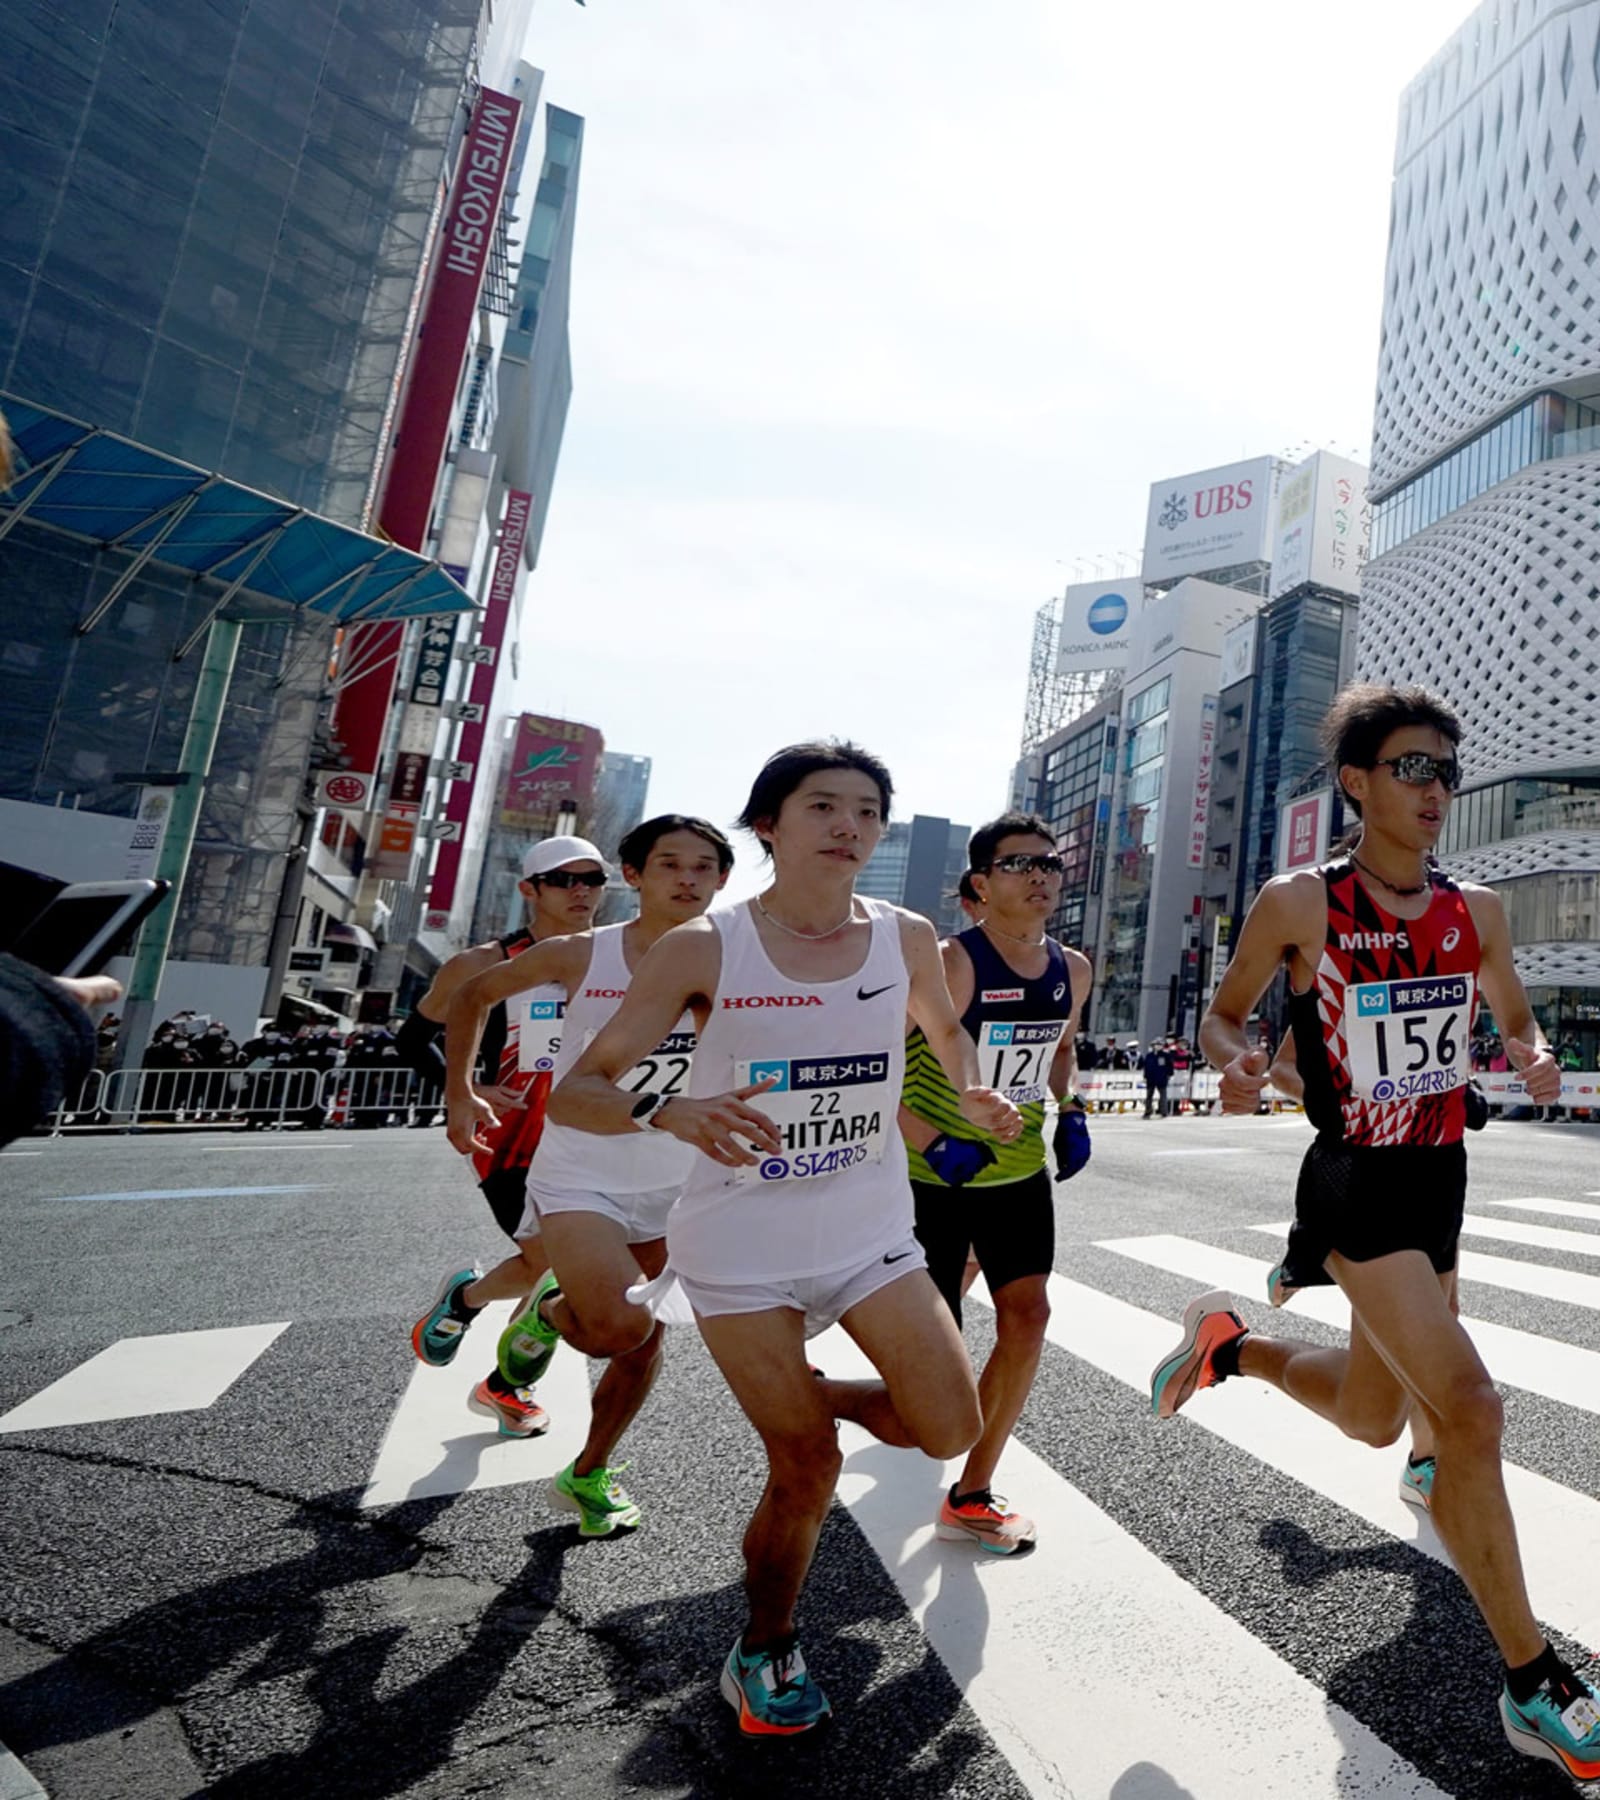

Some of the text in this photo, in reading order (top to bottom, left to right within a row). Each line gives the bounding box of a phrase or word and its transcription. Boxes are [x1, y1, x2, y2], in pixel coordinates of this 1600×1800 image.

[446, 101, 512, 276] MITSUKOSHI
[1194, 480, 1253, 519] UBS
[492, 498, 527, 600] MITSUKOSHI
[1061, 642, 1100, 656] KONICA
[527, 717, 586, 742] S&B
[1339, 932, 1409, 950] MHPS
[721, 995, 824, 1009] HONDA
[1396, 984, 1464, 1006] 東京メトロ
[1015, 1027, 1059, 1040] 東京メトロ
[1376, 1012, 1458, 1077] 156
[797, 1060, 884, 1082] 東京メトロ
[808, 1092, 841, 1117] 22
[750, 1111, 880, 1152] HITARA
